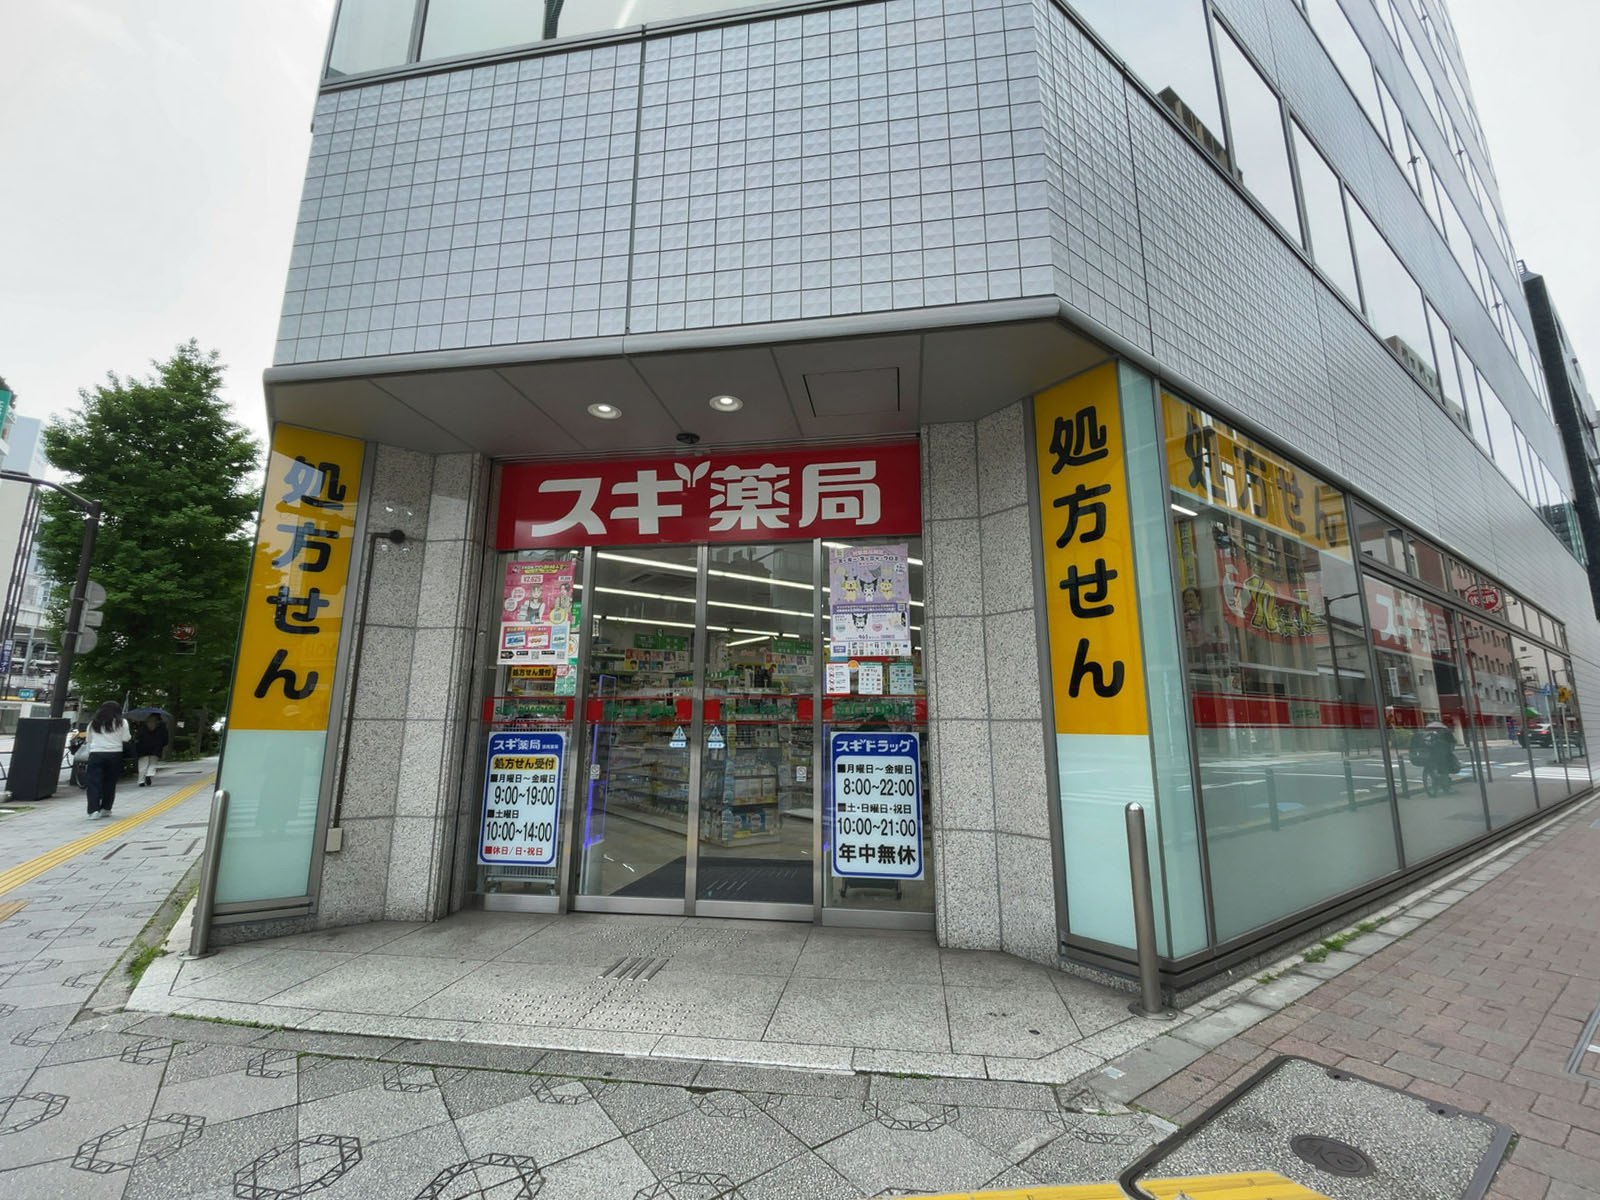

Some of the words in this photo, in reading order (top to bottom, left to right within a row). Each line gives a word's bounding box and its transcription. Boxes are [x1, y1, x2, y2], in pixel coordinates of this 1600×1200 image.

[531, 460, 882, 538] スギ薬局
[1049, 405, 1125, 699] 処方せん
[254, 455, 346, 700] 処方せん
[493, 738, 541, 750] スギ薬局
[835, 738, 914, 752] スギドラッグ
[494, 757, 556, 770] 処方せん受付
[838, 843, 917, 866] 年中無休
